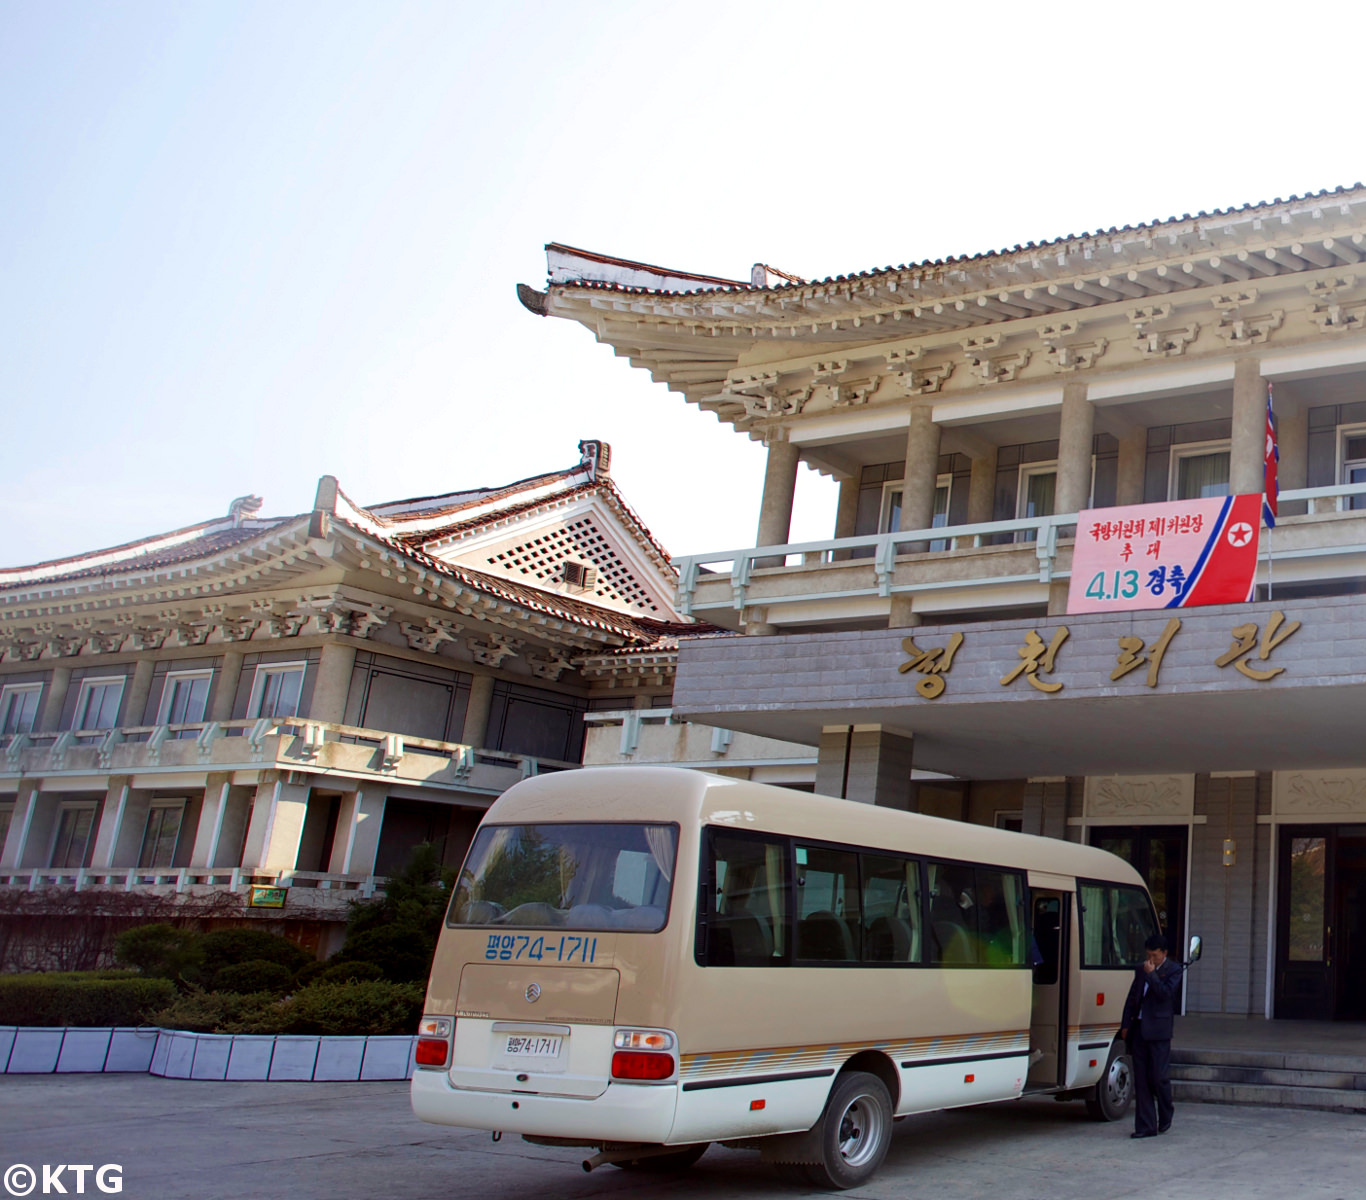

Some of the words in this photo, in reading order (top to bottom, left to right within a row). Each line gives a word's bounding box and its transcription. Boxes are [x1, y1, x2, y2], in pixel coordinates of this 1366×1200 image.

[1089, 518, 1145, 542] 국방위원회
[1085, 569, 1139, 600] 4.13
[1144, 565, 1187, 596] 경축
